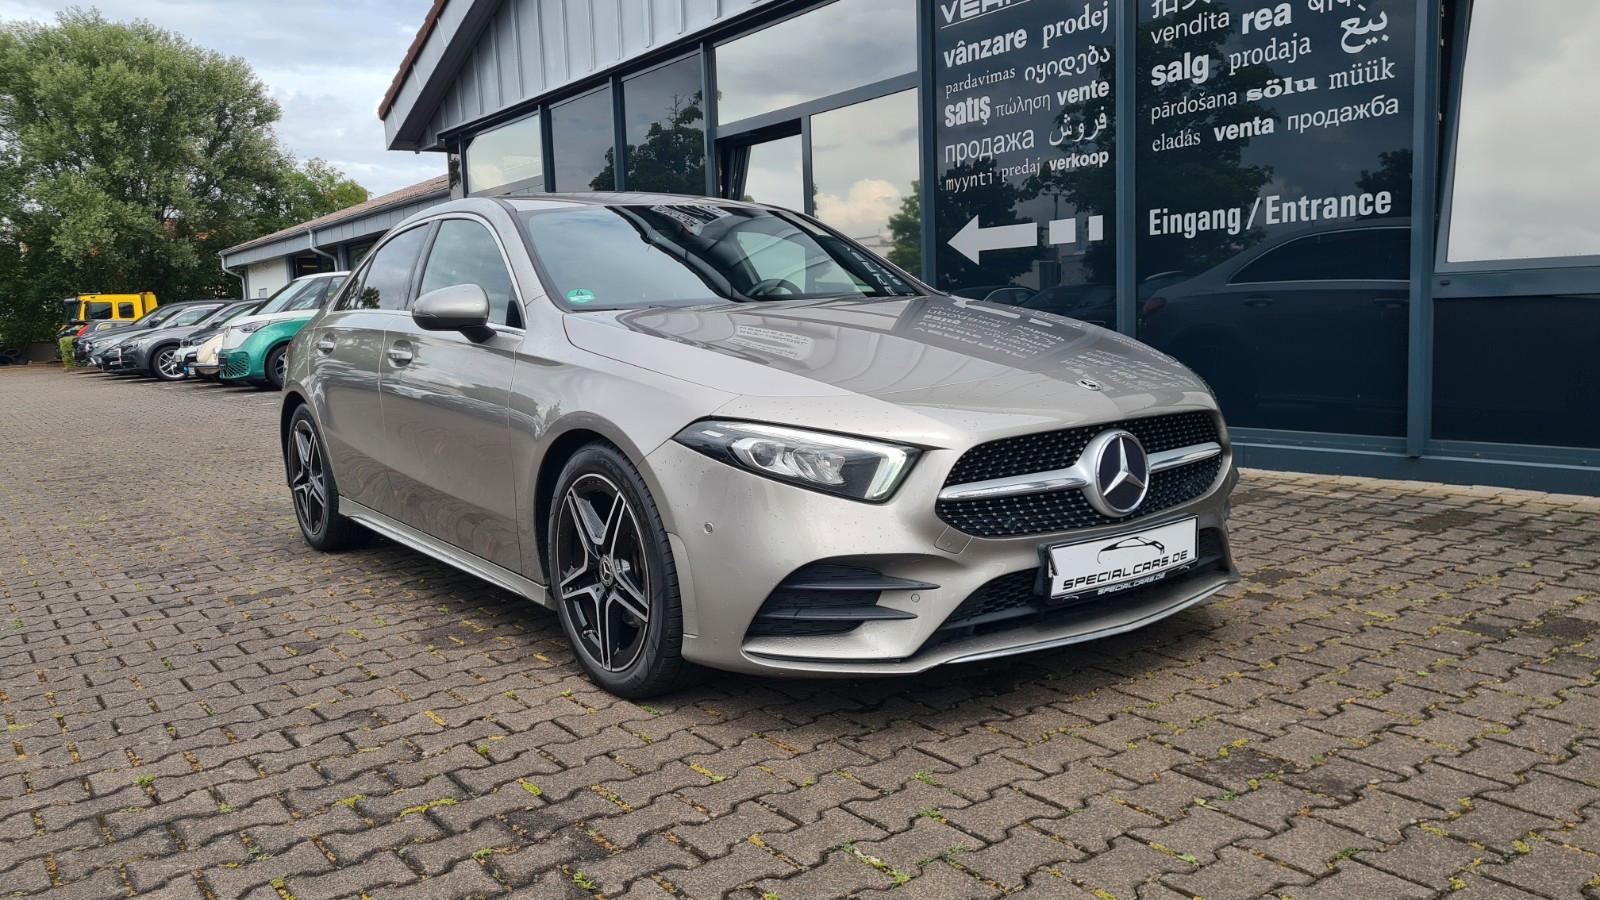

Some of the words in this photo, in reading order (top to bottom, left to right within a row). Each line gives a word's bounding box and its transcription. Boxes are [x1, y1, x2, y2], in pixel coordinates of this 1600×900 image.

[944, 29, 1027, 68] vânzare
[1042, 1, 1108, 49] prodej
[1151, 12, 1229, 44] vendita
[1242, 2, 1292, 34] rea
[1025, 45, 1110, 84] იყიდება
[1151, 52, 1209, 86] salg
[1228, 33, 1311, 75] prodaja
[946, 68, 1015, 99] pardavimas
[1057, 80, 1109, 106] vente
[1151, 91, 1237, 125] pārdošana
[1246, 77, 1318, 102] sölu
[1329, 57, 1395, 90] müük
[945, 96, 991, 127] satış
[995, 94, 1050, 117] πώληση
[1287, 95, 1399, 133] продажба
[945, 129, 1034, 167] продажа
[1152, 129, 1201, 151] eladás
[1214, 116, 1275, 142] venta
[946, 169, 993, 194] myynti
[1002, 157, 1041, 183] predaj
[1049, 150, 1109, 171] verkoop
[1149, 207, 1241, 239] Eingang
[1265, 191, 1392, 225] Entrance
[1063, 550, 1188, 590] SPECIALCARS.DE
